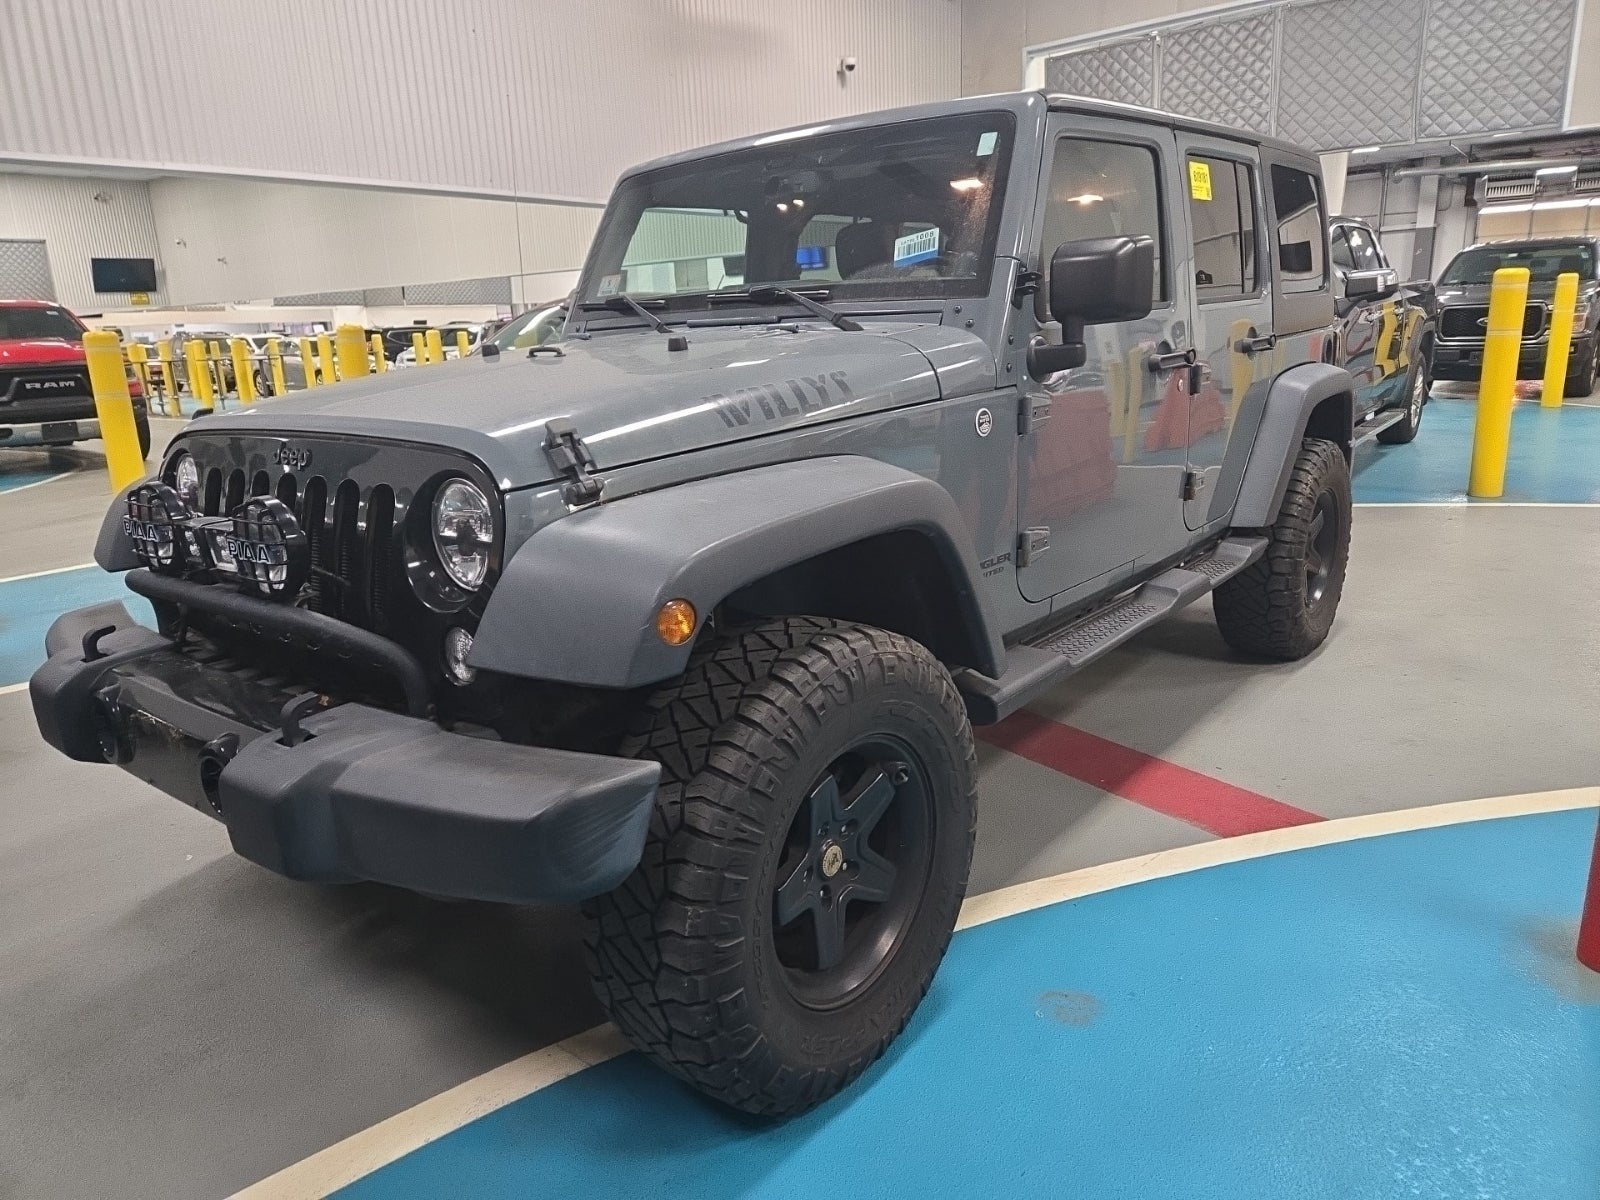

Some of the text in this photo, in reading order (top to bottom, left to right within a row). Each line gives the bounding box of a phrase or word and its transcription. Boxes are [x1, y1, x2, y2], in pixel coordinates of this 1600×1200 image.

[25, 380, 75, 390] RAM
[701, 370, 853, 428] WILLYS
[272, 446, 310, 471] Jeep
[123, 519, 160, 542] PIAA
[226, 537, 272, 564] PIAA
